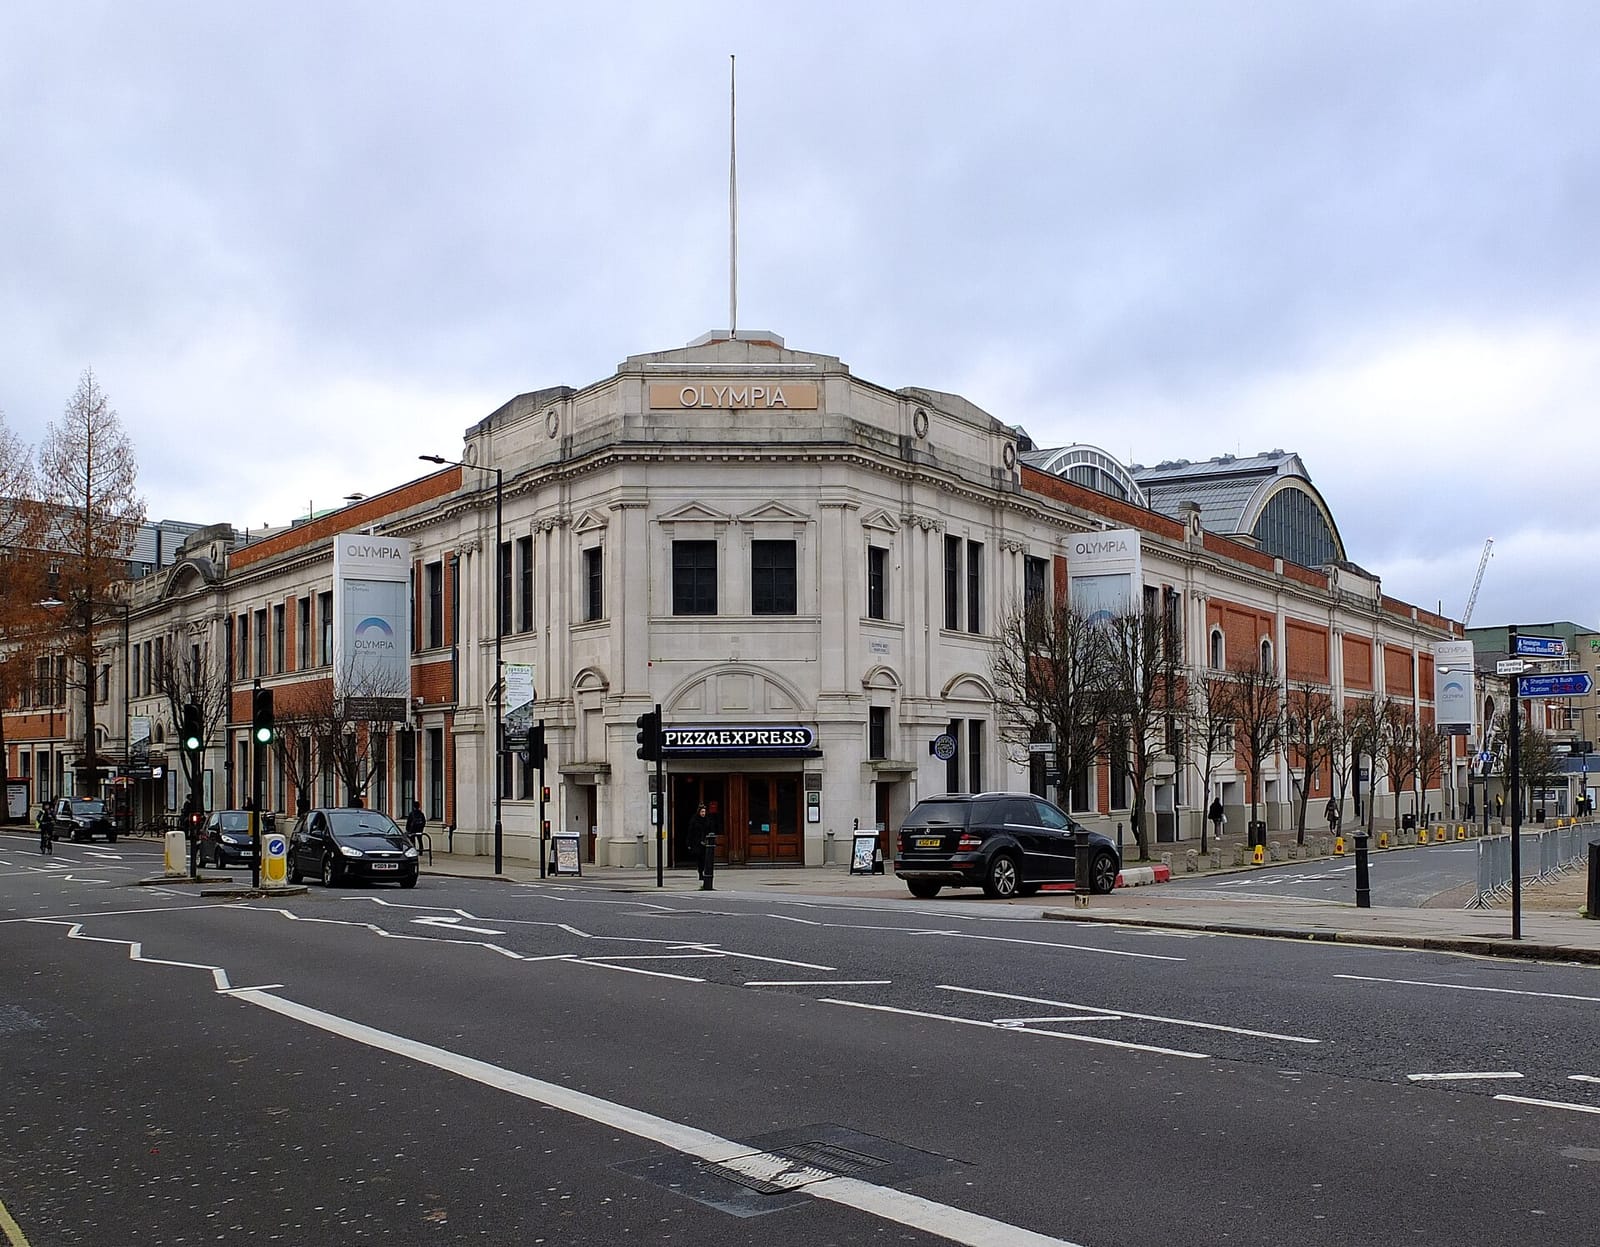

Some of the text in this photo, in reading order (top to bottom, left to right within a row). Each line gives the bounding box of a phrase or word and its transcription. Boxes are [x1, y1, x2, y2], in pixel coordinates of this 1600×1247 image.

[679, 386, 788, 408] OLYMPIA
[346, 545, 402, 560] OLYMPIA
[1075, 540, 1128, 555] OLYMPIA
[354, 640, 394, 650] OLYMPIA
[1438, 646, 1468, 654] OLYMPIA
[1529, 677, 1559, 685] Shepherd's
[665, 731, 806, 745] PIZZAEXPRESS
